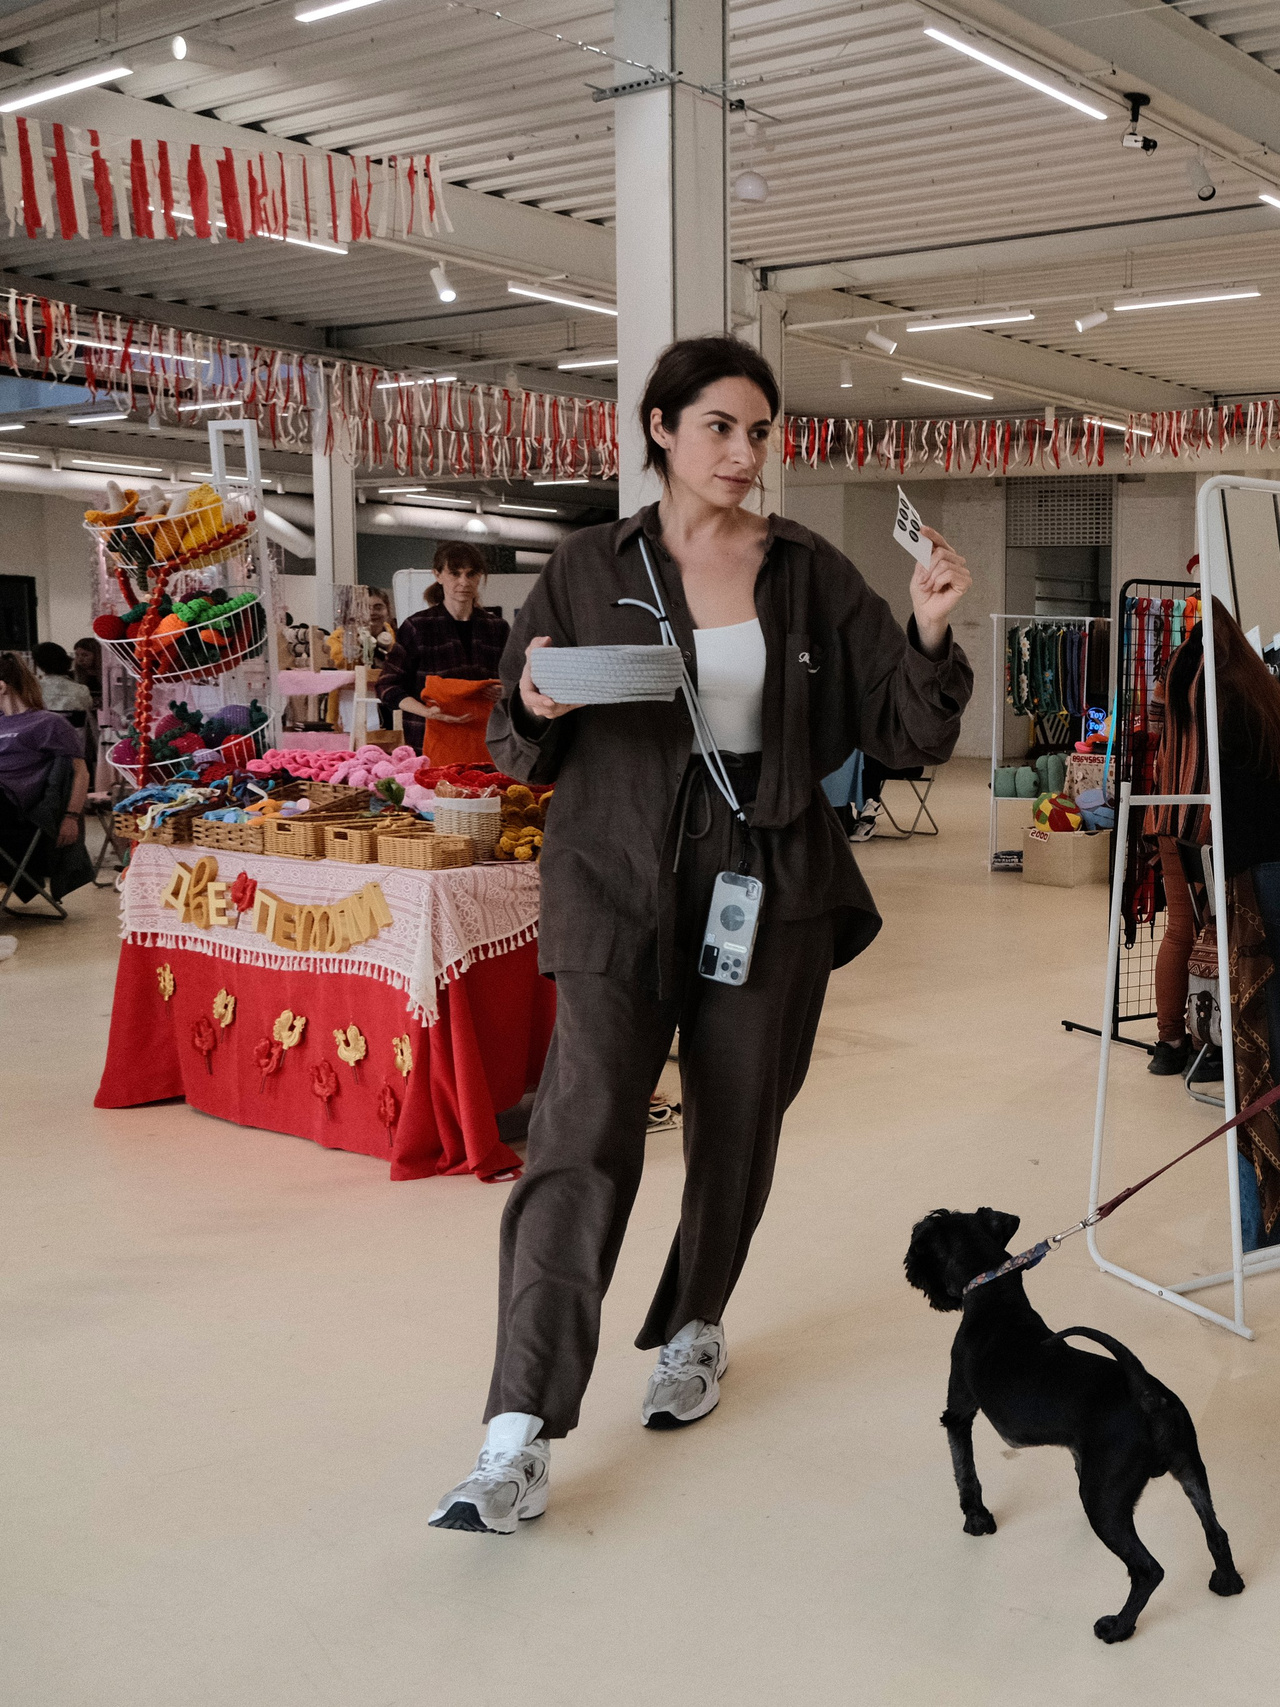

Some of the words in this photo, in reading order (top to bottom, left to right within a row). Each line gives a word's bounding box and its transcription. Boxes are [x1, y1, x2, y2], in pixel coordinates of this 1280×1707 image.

[1089, 710, 1104, 720] Toy
[1089, 722, 1104, 731] For
[1030, 829, 1049, 841] 2000
